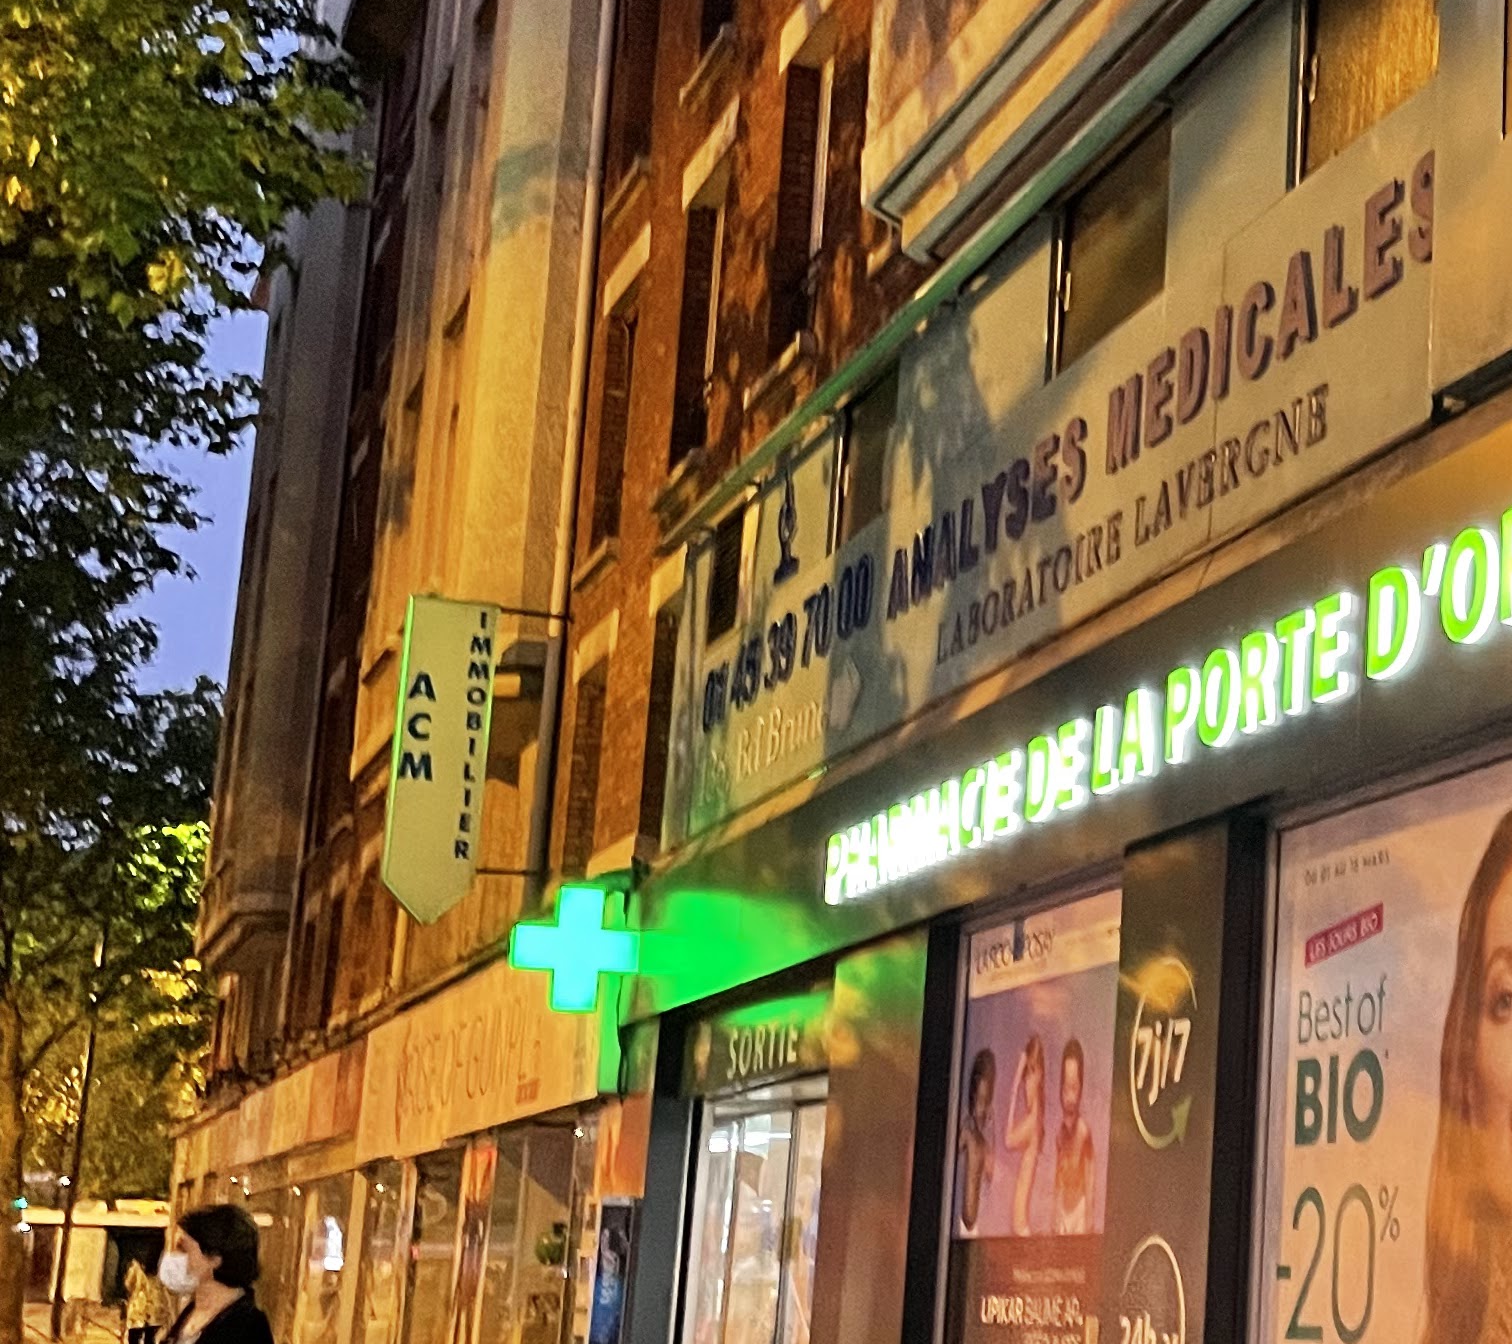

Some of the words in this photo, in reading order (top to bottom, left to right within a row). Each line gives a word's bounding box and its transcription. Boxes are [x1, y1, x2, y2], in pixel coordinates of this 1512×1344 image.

[801, 582, 834, 669] 70
[837, 554, 874, 640] 00
[886, 417, 1087, 620] ANALYSES
[936, 505, 1123, 665] LABORATOIRE
[1134, 383, 1329, 547] LAVERGNE
[397, 671, 437, 782] ACM
[454, 611, 492, 860] IMMOBILIER
[824, 748, 1023, 906] PHARMACIE
[1025, 718, 1090, 823] DE
[1092, 688, 1153, 795] LA
[1166, 591, 1353, 764] PORTE
[727, 1024, 797, 1080] SORTIE
[1137, 1018, 1191, 1105] 7j/7
[1297, 987, 1352, 1045] Best
[1356, 975, 1387, 1034] of
[1295, 1049, 1384, 1146] BIO
